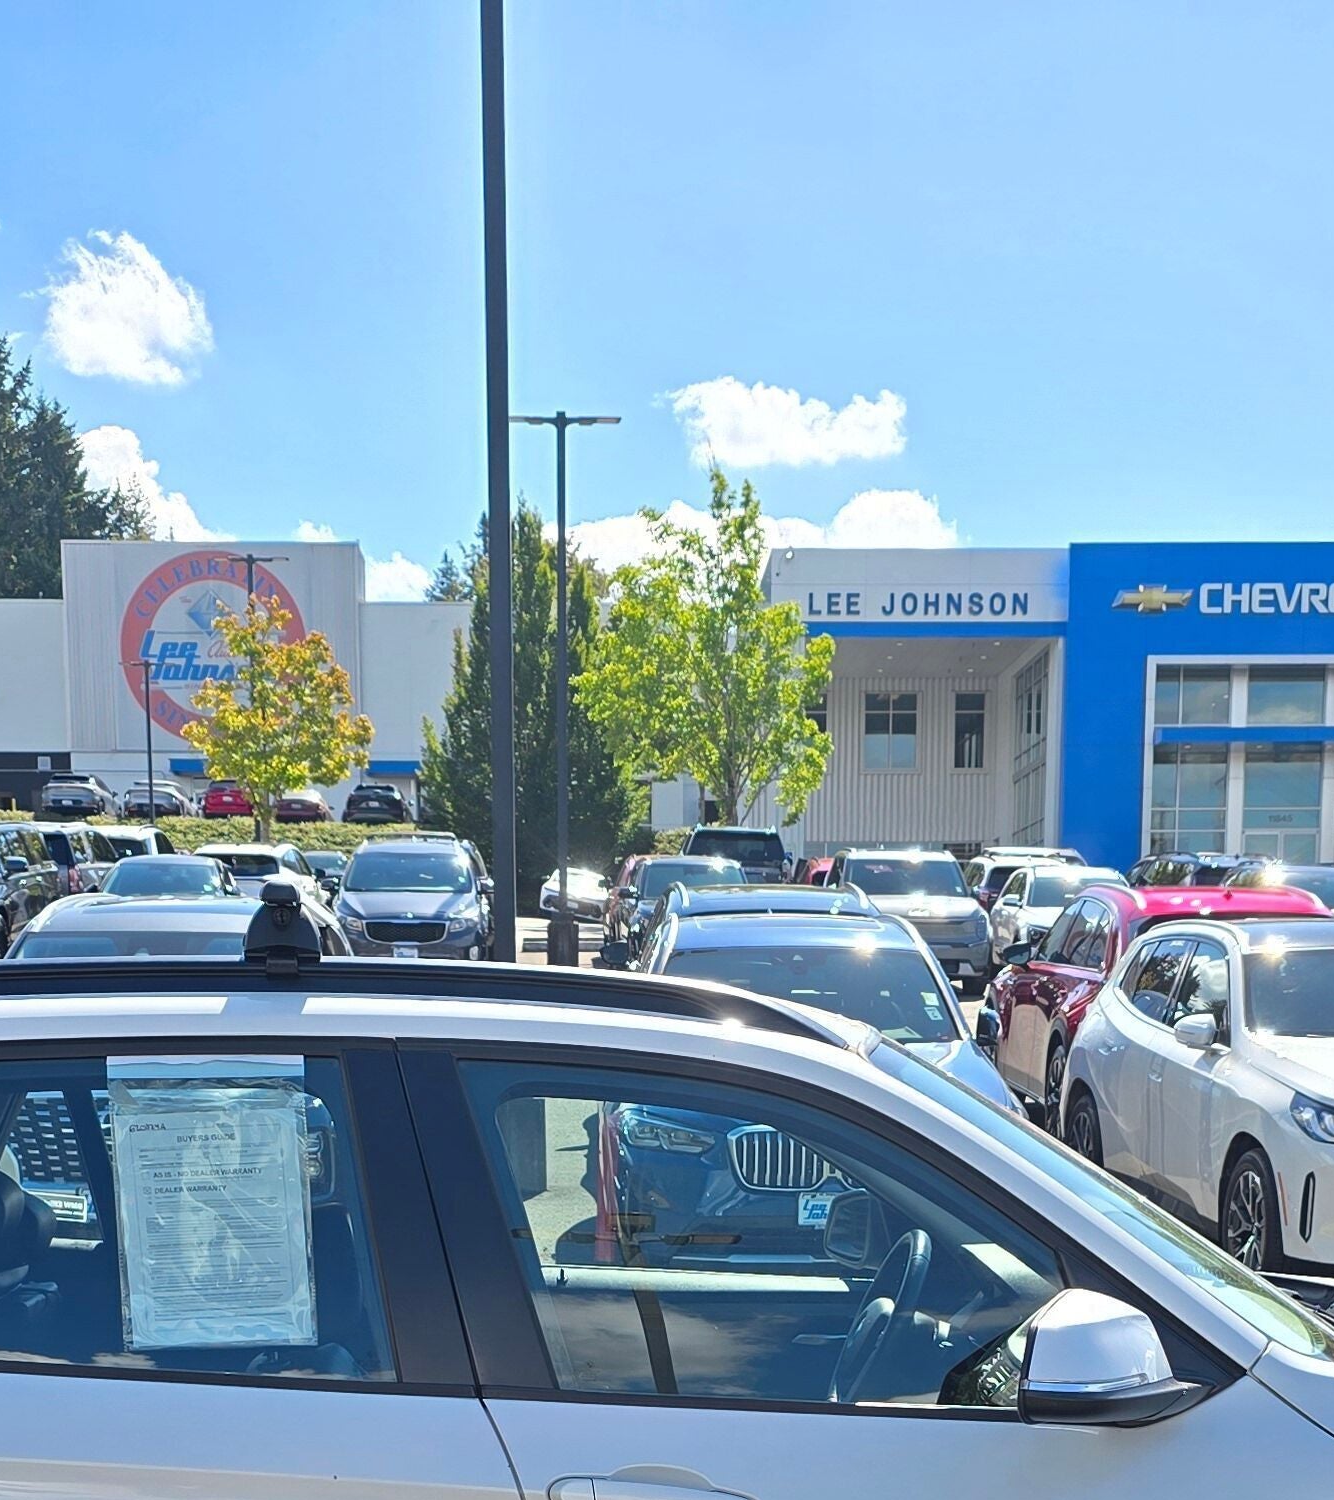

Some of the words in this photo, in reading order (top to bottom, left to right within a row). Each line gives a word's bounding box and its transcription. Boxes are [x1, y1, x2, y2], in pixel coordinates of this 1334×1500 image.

[808, 592, 861, 616] LEE
[881, 592, 1029, 616] JOHNSON
[141, 630, 201, 658] Lee
